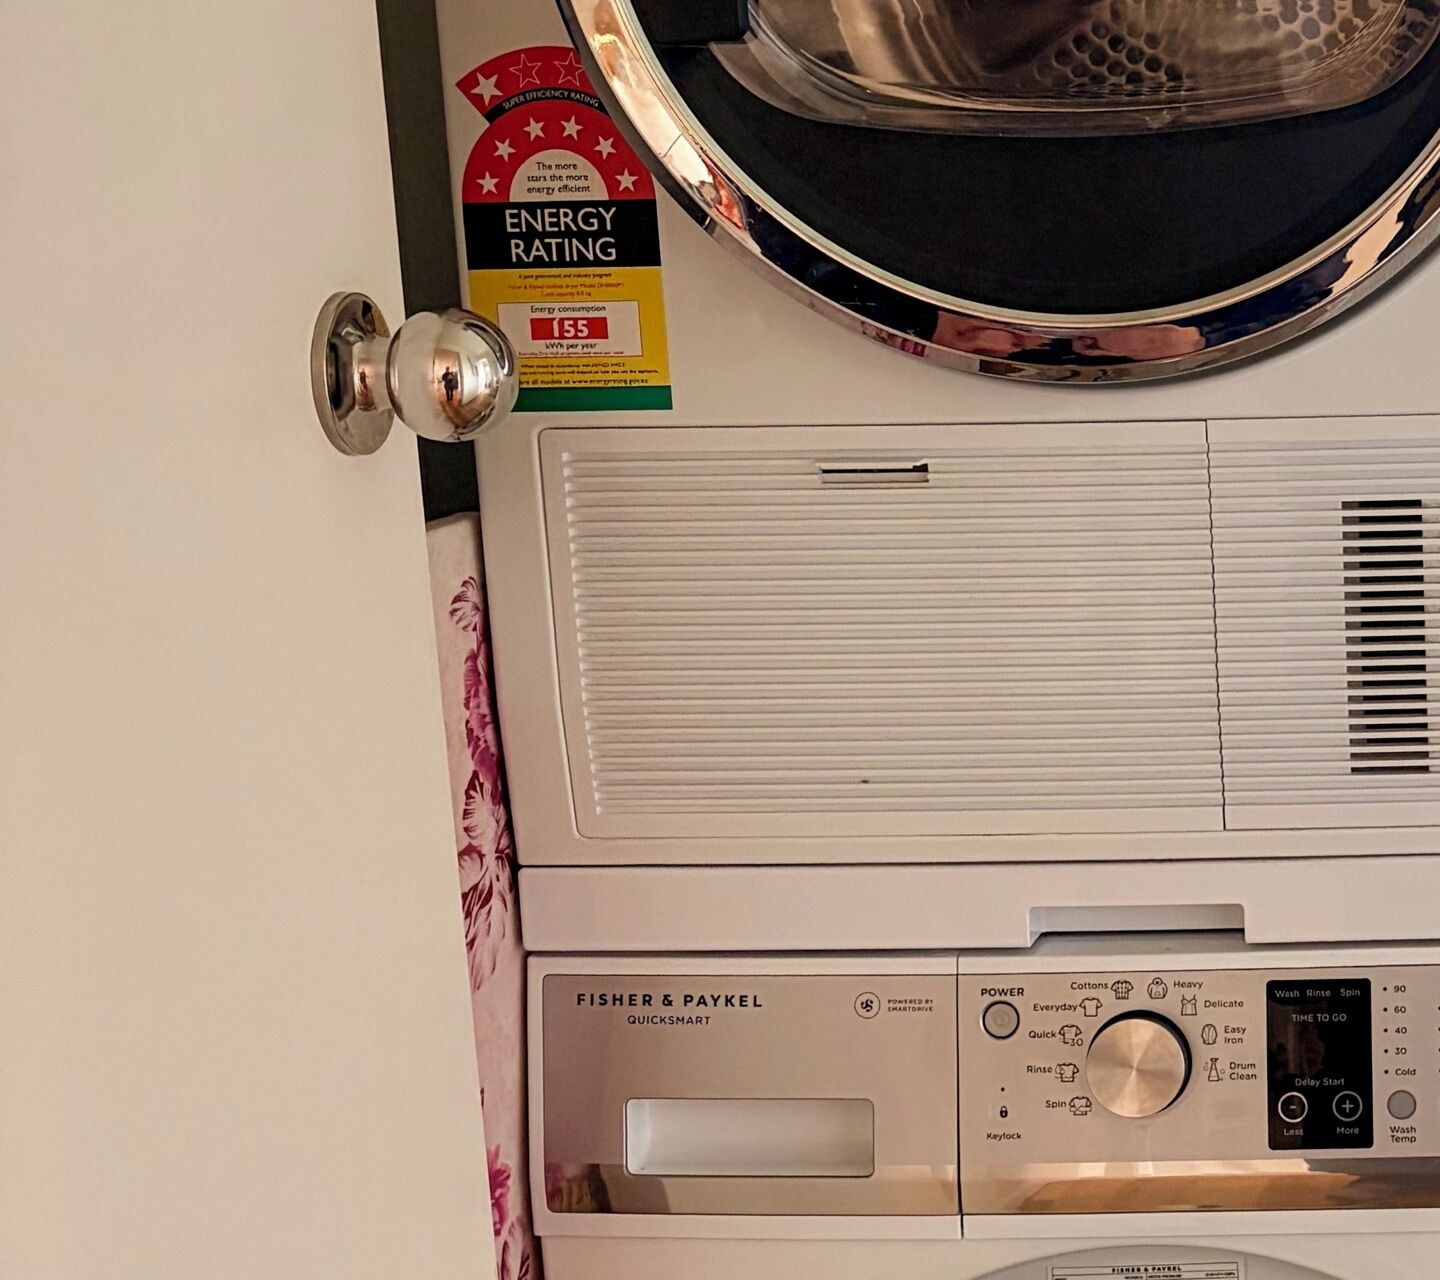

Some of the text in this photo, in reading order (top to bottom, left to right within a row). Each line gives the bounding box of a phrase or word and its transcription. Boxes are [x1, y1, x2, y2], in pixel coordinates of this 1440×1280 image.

[536, 162, 552, 171] The
[550, 173, 589, 182] the more
[527, 184, 591, 195] energy efficient
[505, 207, 617, 233] ENERGY
[510, 237, 617, 263] RATING
[530, 304, 606, 315] Energy consumption
[552, 319, 589, 338] 155
[566, 343, 579, 351] per
[1070, 981, 1108, 990] Cottons
[1174, 980, 1203, 989] Heavy
[1393, 985, 1407, 993] 90
[980, 988, 1024, 997] POWER
[1275, 989, 1360, 998] Wash Rinse Spin
[576, 993, 762, 1007] FISHER & PAYKEL
[1204, 1000, 1244, 1008] Delicate
[1033, 1003, 1077, 1012] Everyday
[1394, 1006, 1407, 1014] 60
[627, 1015, 711, 1025] QUICKSMART
[1292, 1014, 1313, 1022] TIME
[1332, 1013, 1347, 1021] GO
[1028, 1030, 1056, 1039] Quick
[1224, 1025, 1246, 1035] Easy
[1394, 1026, 1407, 1035] 40
[1394, 1047, 1407, 1055] 30
[1026, 1065, 1053, 1074] Rinse
[1229, 1061, 1256, 1070] Drum
[1229, 1072, 1257, 1080] Clean
[1395, 1068, 1416, 1076] Cold
[1295, 1077, 1345, 1087] Delay Start
[1046, 1100, 1067, 1109] Spin
[1390, 1125, 1416, 1134] Wash
[986, 1132, 1021, 1141] Keylock
[1390, 1134, 1416, 1144] Temp
